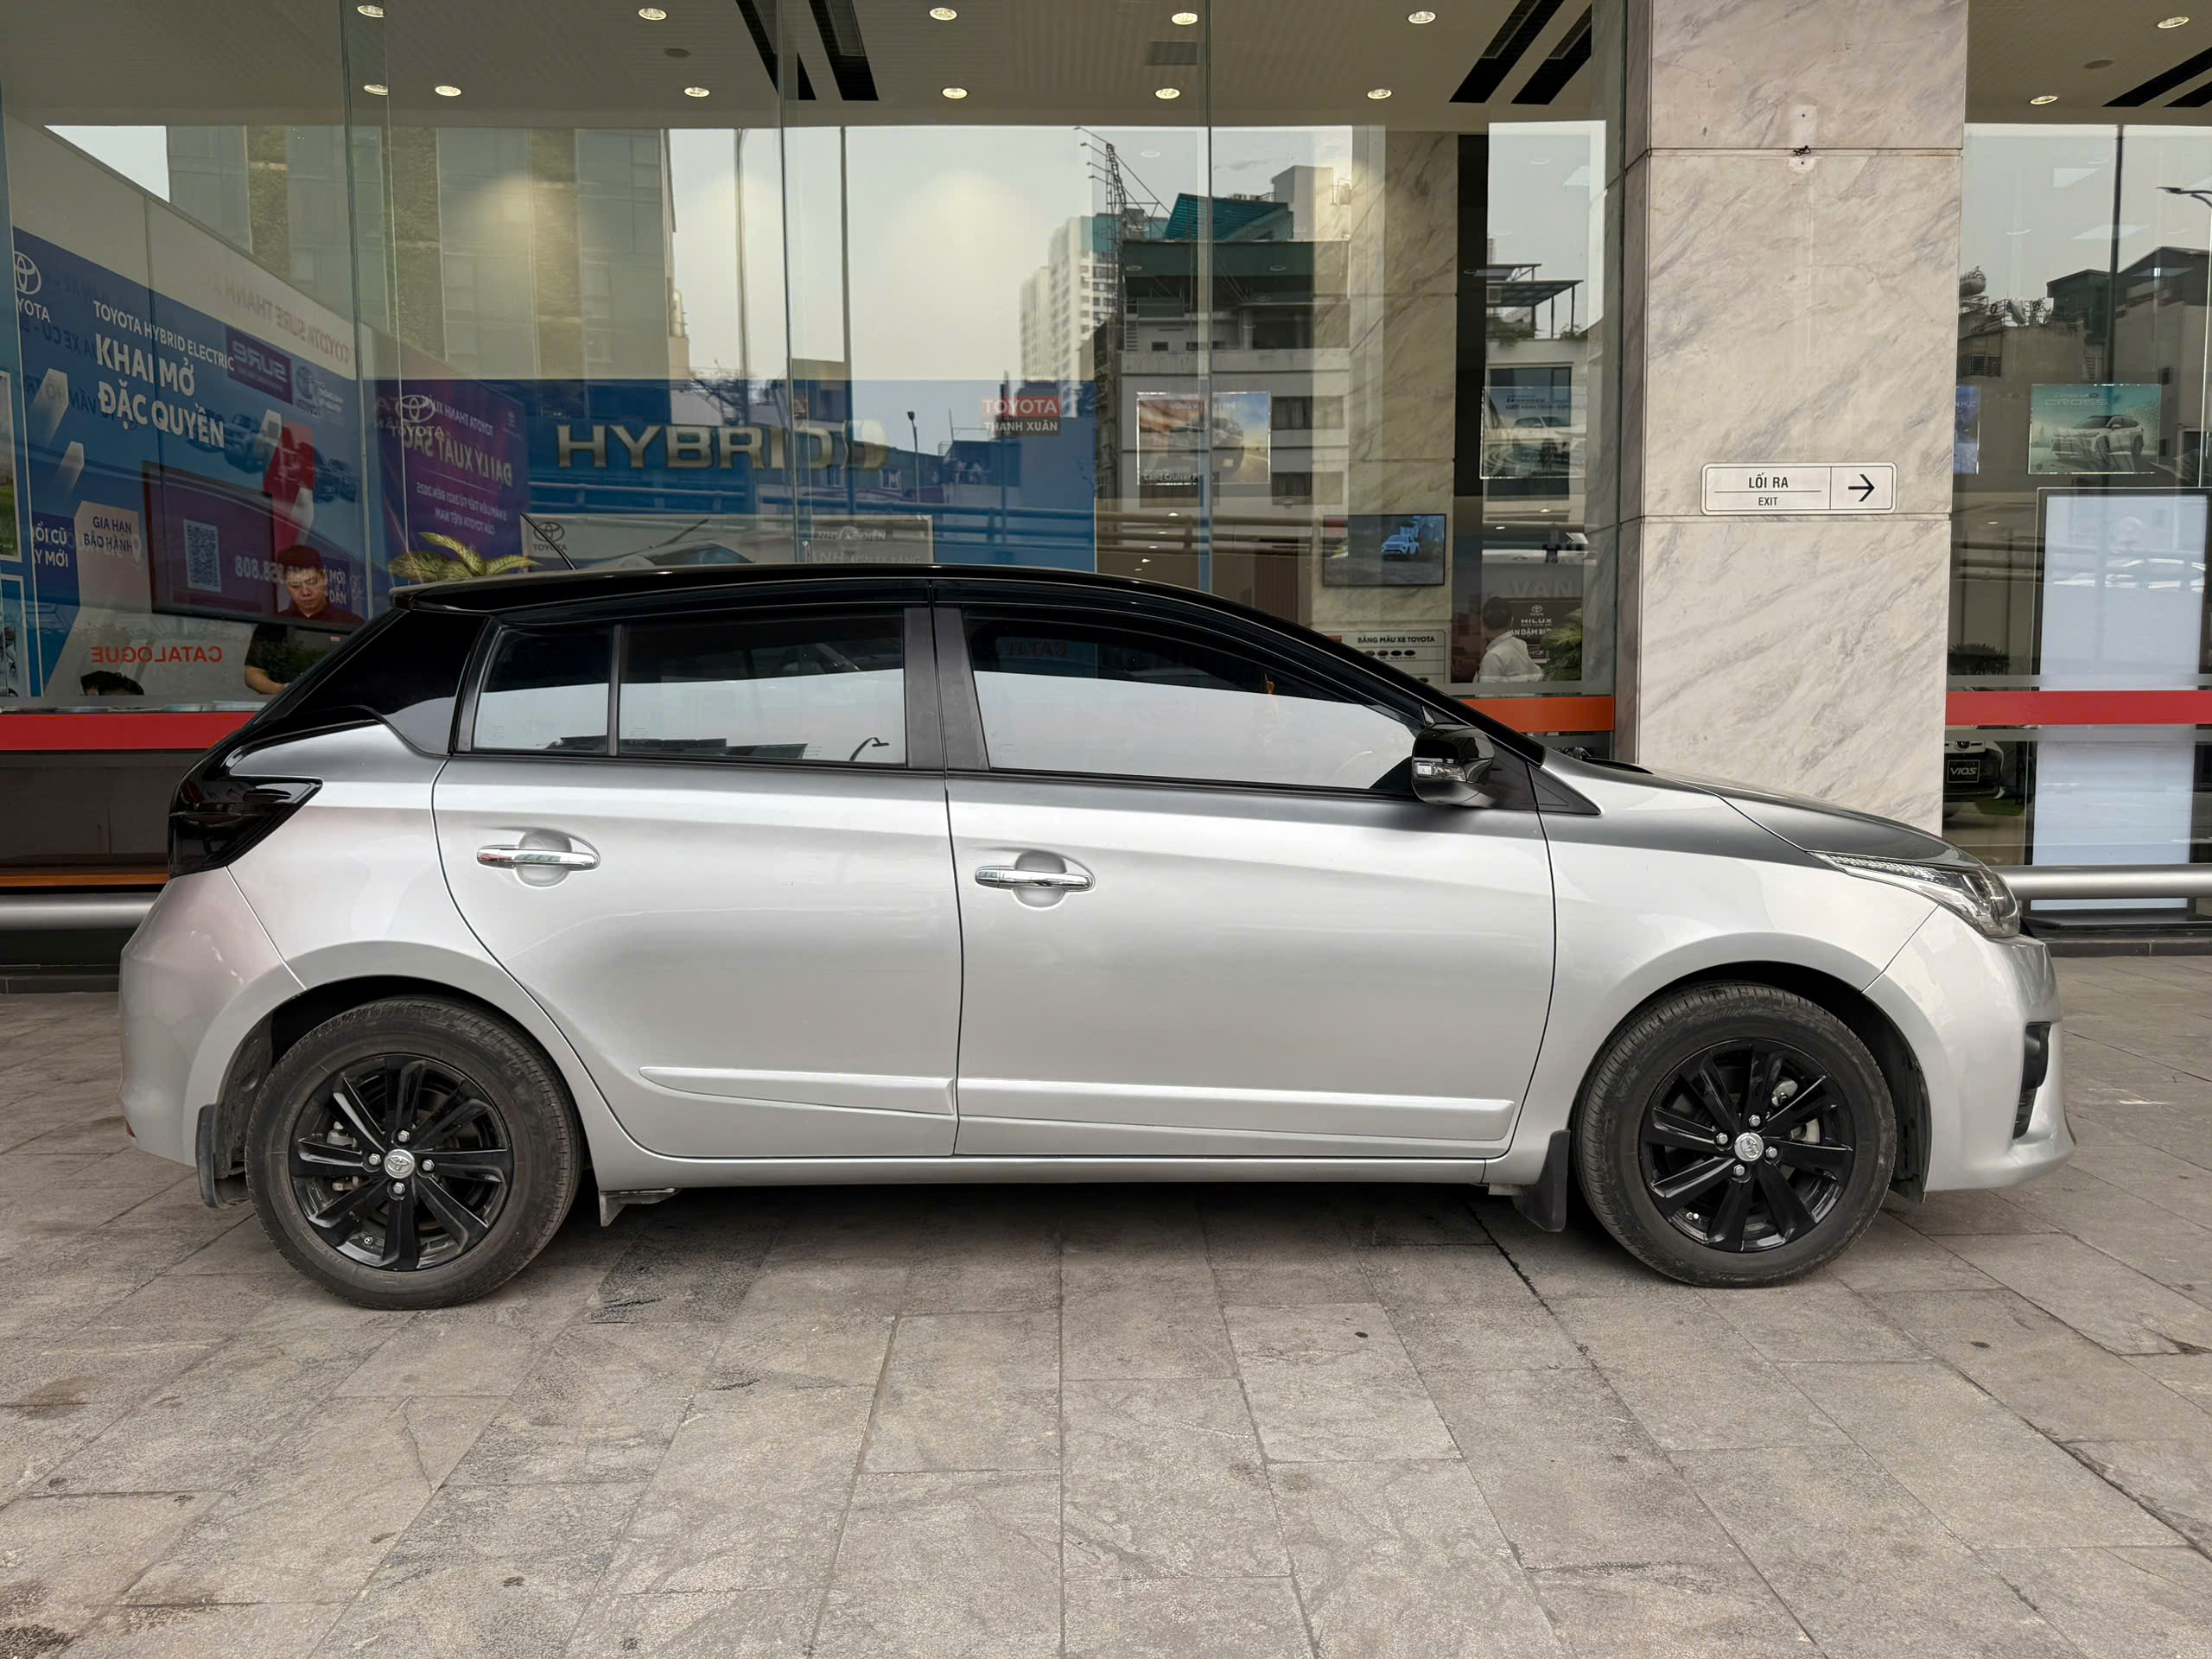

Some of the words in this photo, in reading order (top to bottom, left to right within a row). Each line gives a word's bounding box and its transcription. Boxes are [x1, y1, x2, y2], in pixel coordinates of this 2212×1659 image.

[16, 296, 51, 324] YOTA
[92, 299, 143, 336] TOYOTA
[144, 321, 185, 352] HYBRID
[187, 340, 235, 372] ELECTRIC
[95, 333, 154, 385] KHAI
[159, 356, 195, 397] MỞ
[98, 378, 149, 430] ĐẶC
[152, 400, 225, 449] QUYỀN
[982, 399, 1058, 414] TOYOTA
[391, 425, 445, 439] TOYOTA
[983, 421, 1023, 432] THANH
[1027, 419, 1058, 432] XUÂN
[556, 423, 835, 470] HYBRID
[1143, 472, 1163, 481] Land
[1164, 472, 1192, 481] Cruiser
[1749, 472, 1767, 489] LỐI
[1772, 476, 1789, 489] RA
[1758, 496, 1778, 506] EXIT
[35, 520, 49, 543] ỔI
[50, 527, 67, 545] CŨ
[92, 516, 111, 531] GIA
[111, 518, 132, 537] HẠN
[83, 530, 105, 548] BẢO
[105, 534, 133, 553] HÀNH
[45, 548, 69, 568] MỚI
[1357, 634, 1378, 644] BẢNG
[1379, 634, 1396, 644] MÀU
